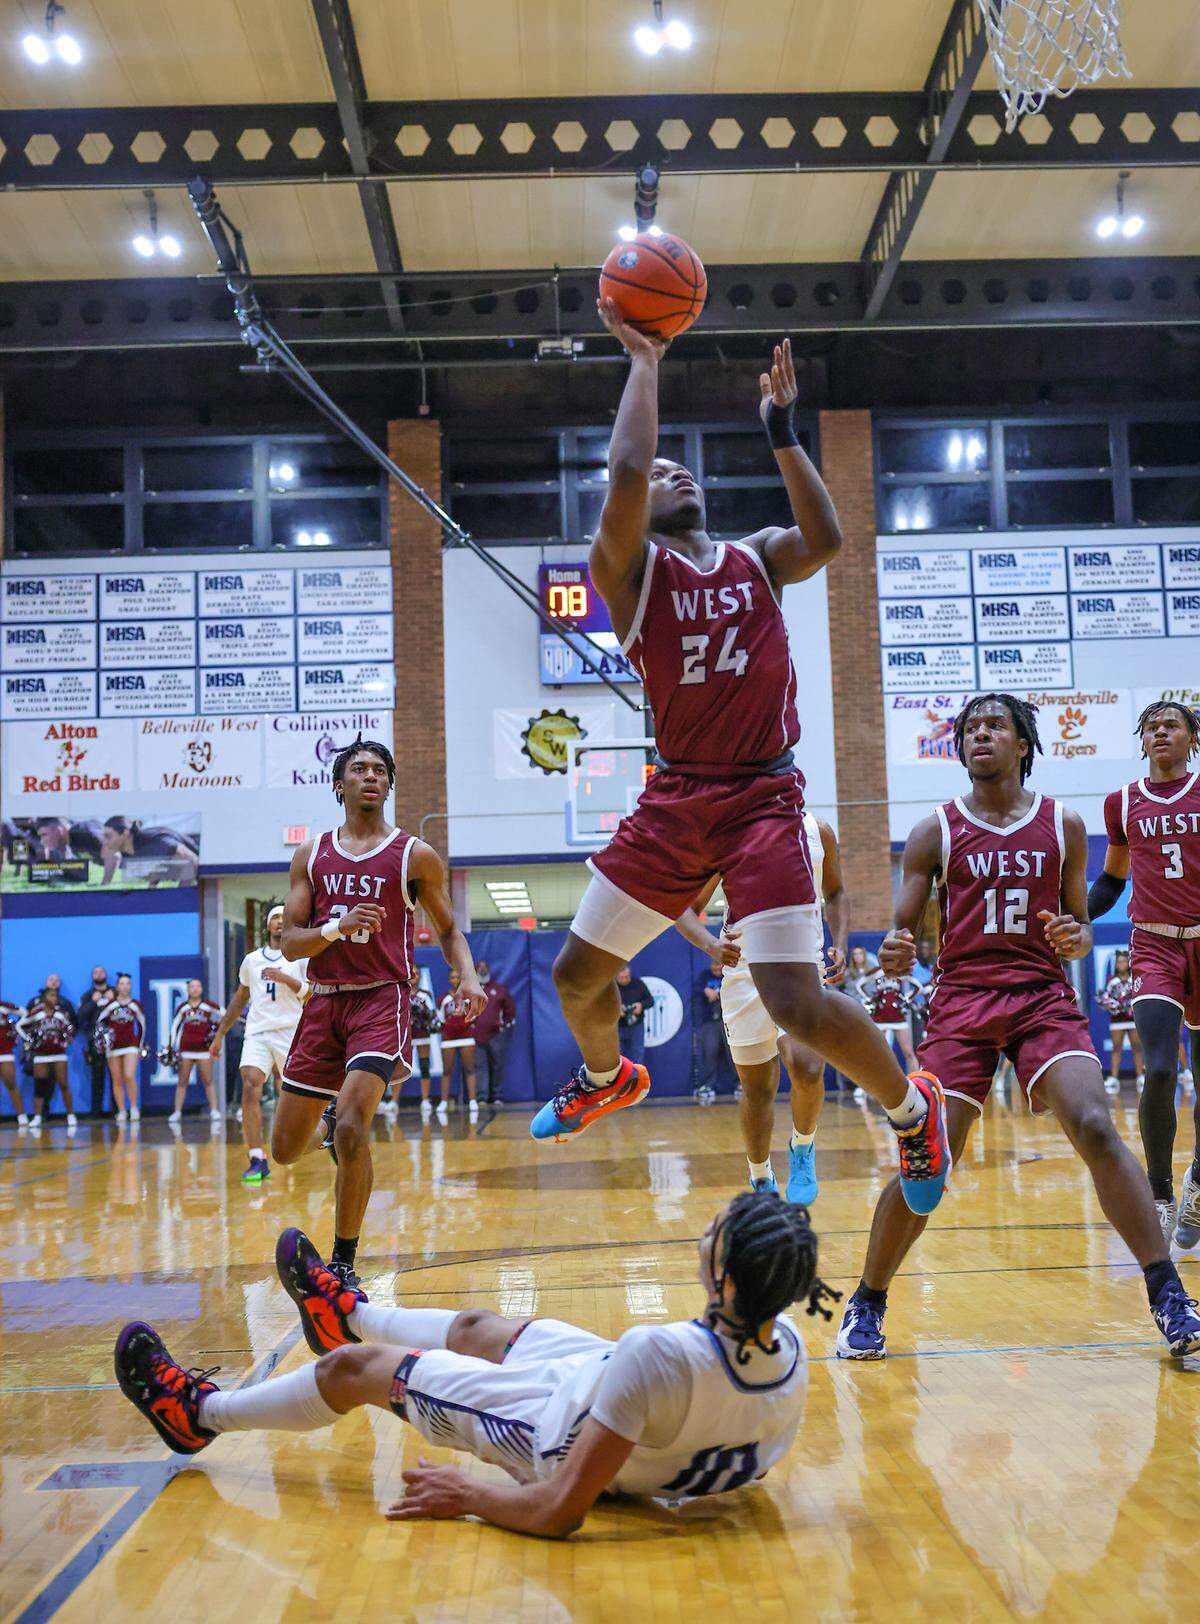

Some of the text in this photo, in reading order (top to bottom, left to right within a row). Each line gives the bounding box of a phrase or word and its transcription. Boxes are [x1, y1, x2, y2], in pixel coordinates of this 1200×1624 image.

[548, 569, 581, 583] Home
[671, 581, 754, 622] WEST
[679, 626, 749, 685] 24
[892, 696, 928, 709] East
[933, 695, 954, 709] St.
[1027, 691, 1119, 706] Edwardsville
[44, 723, 98, 740] Alton
[142, 718, 258, 735] Belleville West
[273, 714, 380, 732] Collinsville
[1052, 742, 1097, 759] Tigers
[23, 774, 120, 793] Red Birds
[160, 773, 242, 788] Maroons
[1138, 812, 1200, 838] WEST
[966, 850, 1047, 879] WEST
[1161, 842, 1185, 880] 3
[323, 873, 387, 899] WEST
[983, 888, 1029, 934] 12
[266, 982, 276, 1001] 4
